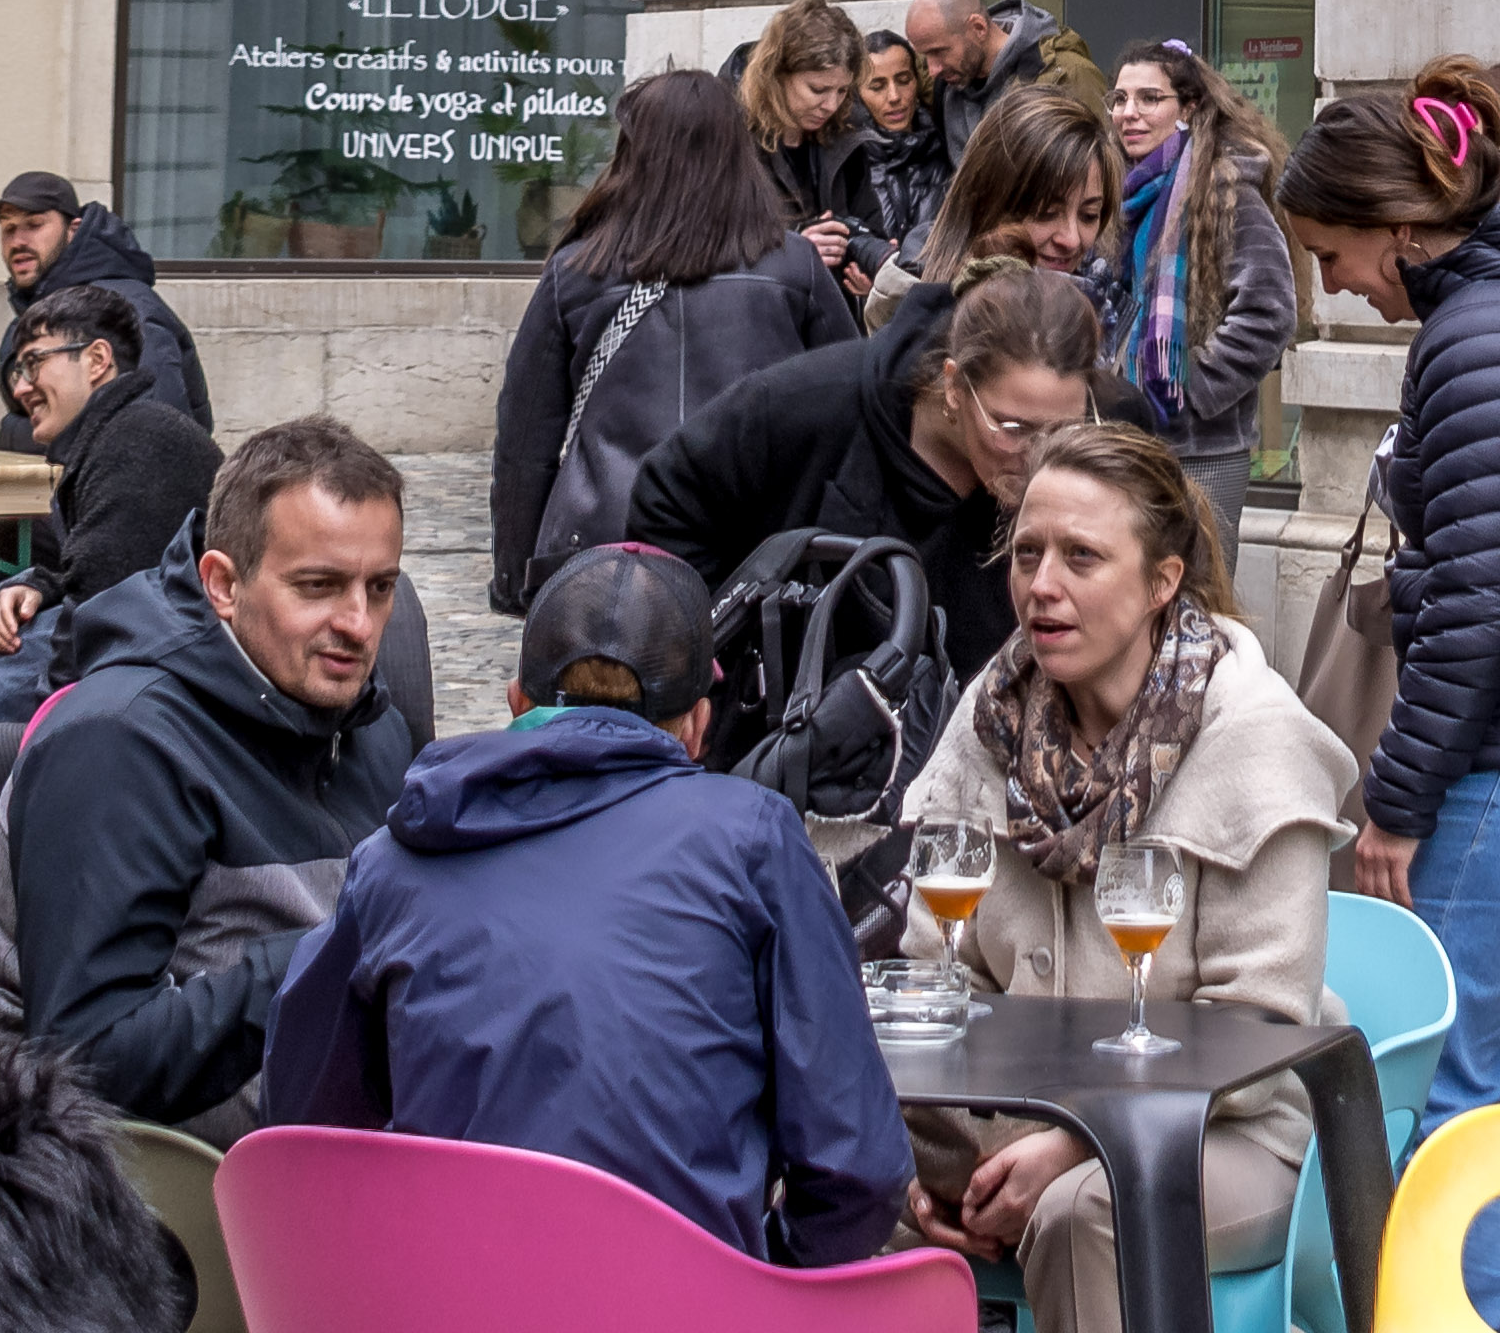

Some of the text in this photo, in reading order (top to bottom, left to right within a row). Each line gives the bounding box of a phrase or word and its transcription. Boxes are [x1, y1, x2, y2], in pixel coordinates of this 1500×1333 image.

[228, 36, 326, 69] Ateliers
[333, 39, 428, 71] créatifs
[435, 49, 452, 73] &
[458, 49, 551, 75] activités
[556, 56, 615, 76] POUR
[305, 82, 607, 124] Cours de yoga et pilates
[343, 129, 564, 164] UNIVERS UNIQUE
